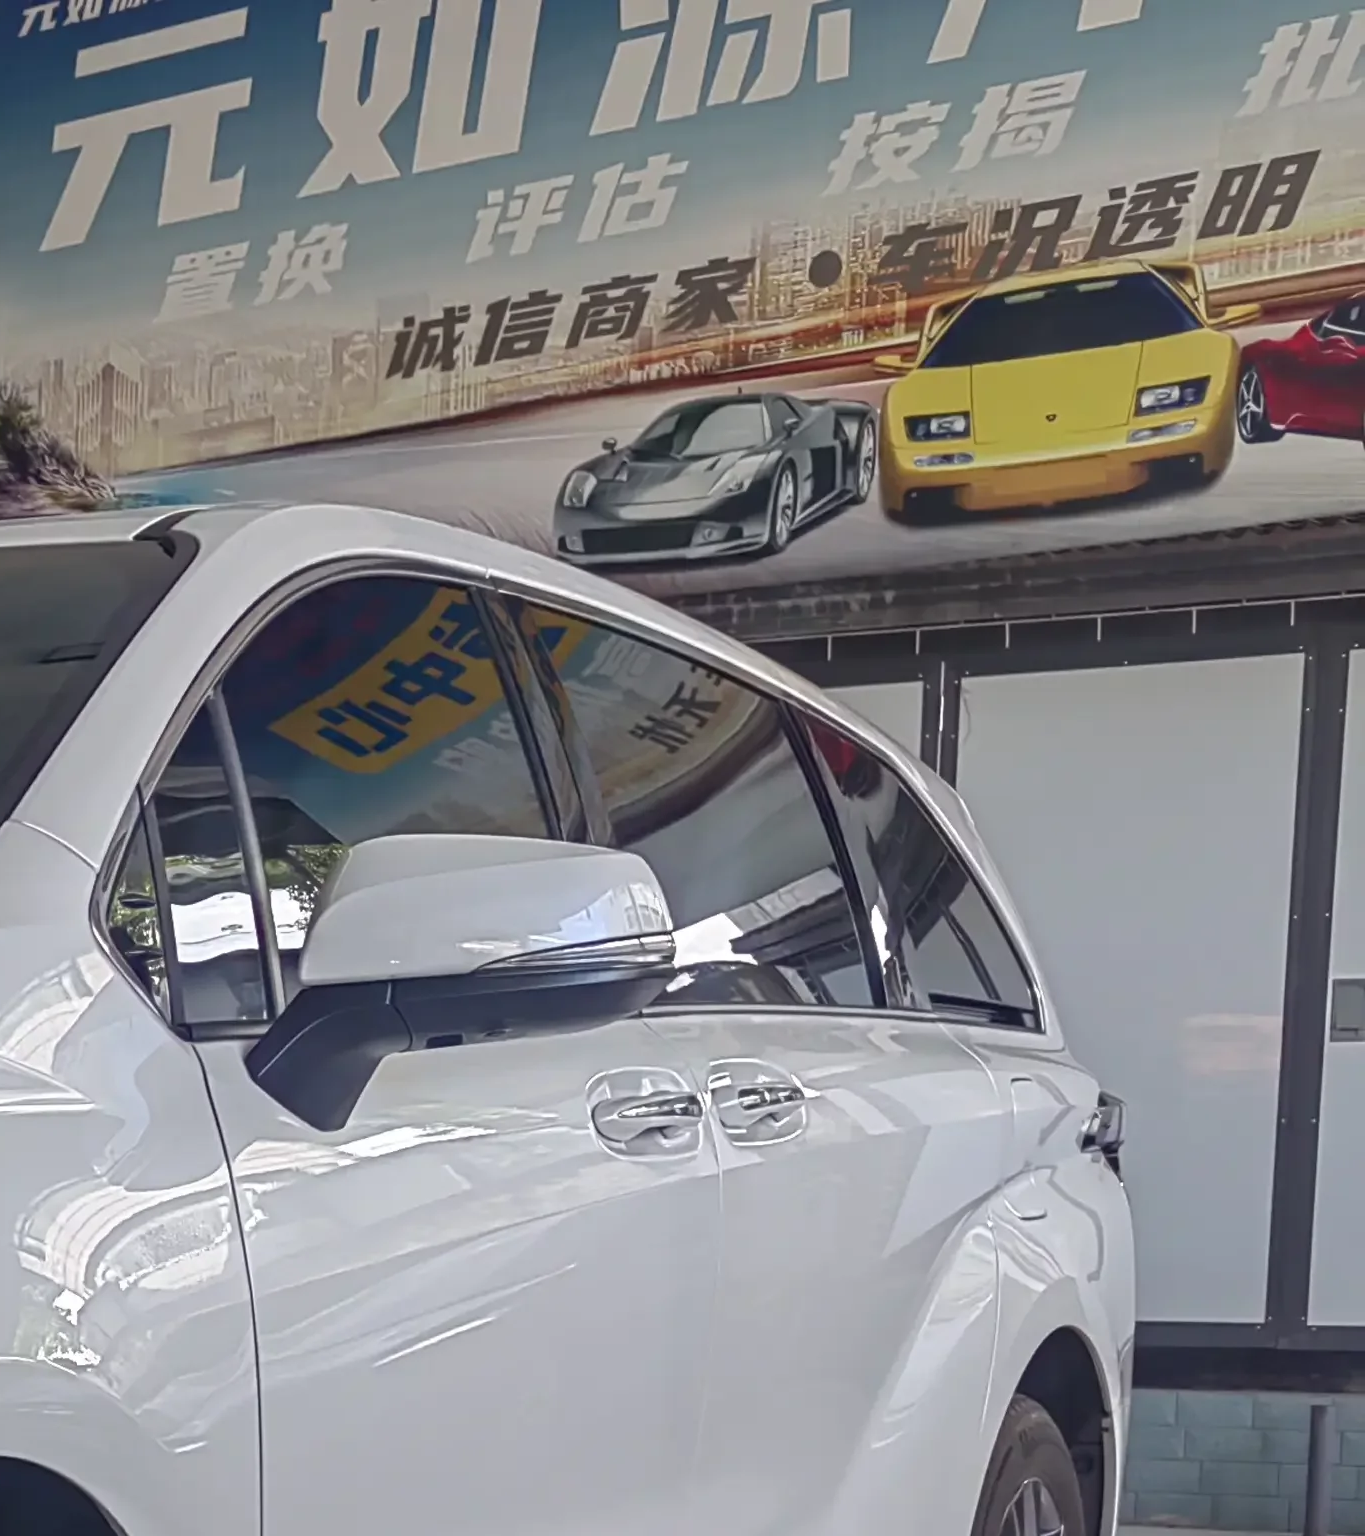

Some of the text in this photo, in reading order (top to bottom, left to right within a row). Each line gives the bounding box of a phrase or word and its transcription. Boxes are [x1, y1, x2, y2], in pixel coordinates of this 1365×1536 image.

[152, 222, 348, 324] 置换
[465, 152, 689, 264] 评估
[823, 69, 1087, 196] 按揭
